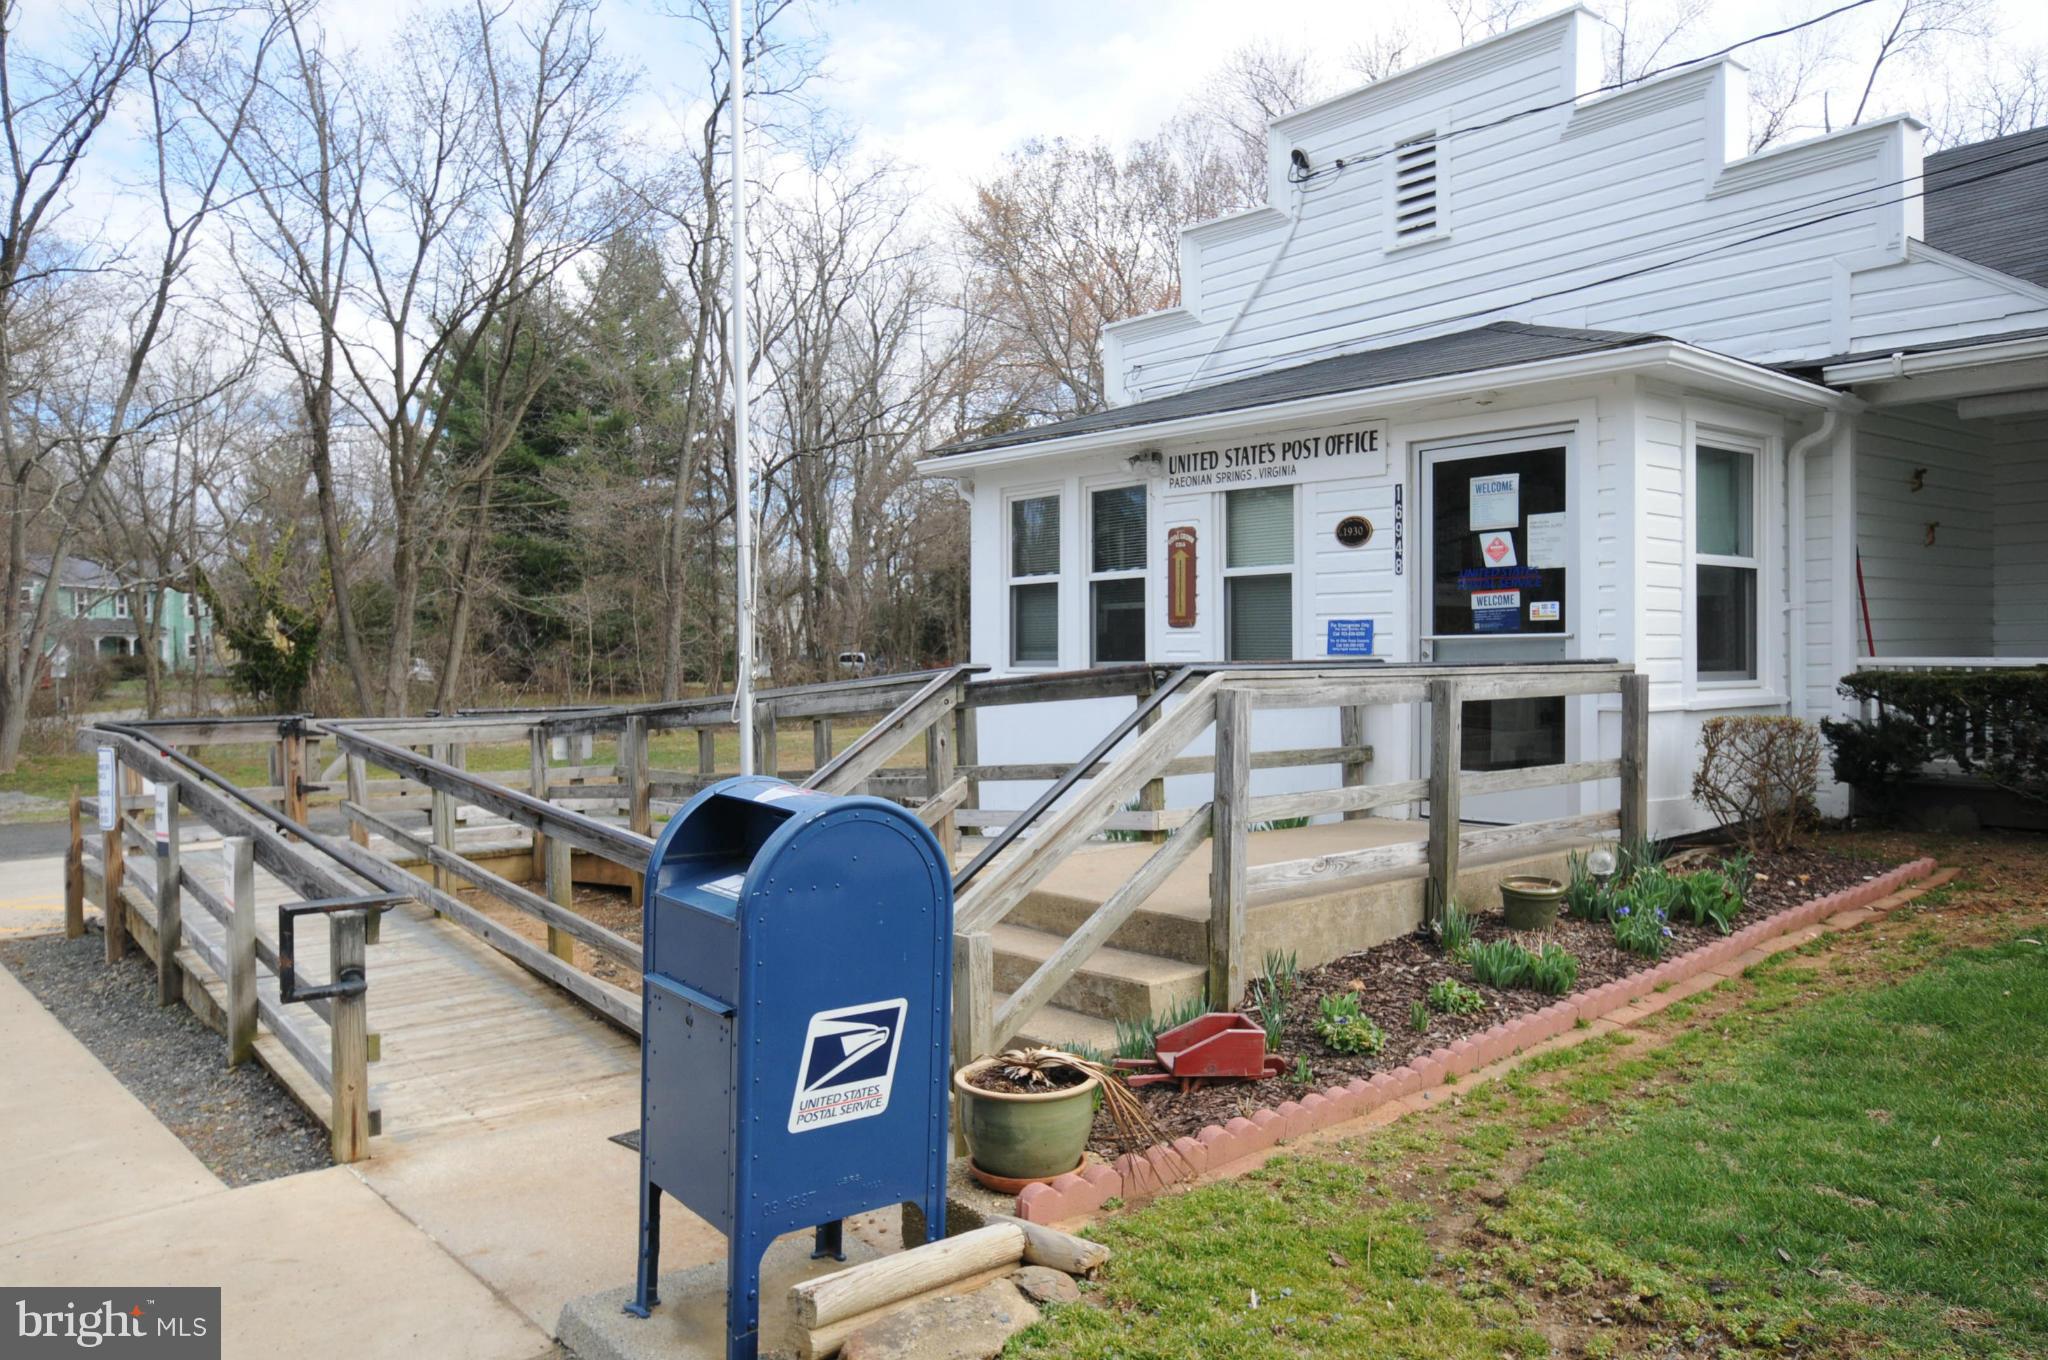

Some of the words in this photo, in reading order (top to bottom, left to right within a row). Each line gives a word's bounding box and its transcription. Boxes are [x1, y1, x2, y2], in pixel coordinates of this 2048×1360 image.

[1168, 450, 1218, 475] UNITED
[1225, 442, 1275, 468] STATES
[1282, 437, 1321, 462] POST
[1325, 430, 1378, 457] OFFICE
[1169, 474, 1212, 489] PAEONIAN
[1259, 464, 1297, 479] VIRGINIA
[1475, 480, 1513, 494] WELCOME
[1395, 485, 1403, 574] 16948
[1476, 594, 1515, 606] WELCOME
[797, 1108, 838, 1125] POSTAL
[840, 1097, 882, 1115] SERVICE
[800, 1093, 841, 1111] UNITED
[843, 1084, 880, 1102] STATES
